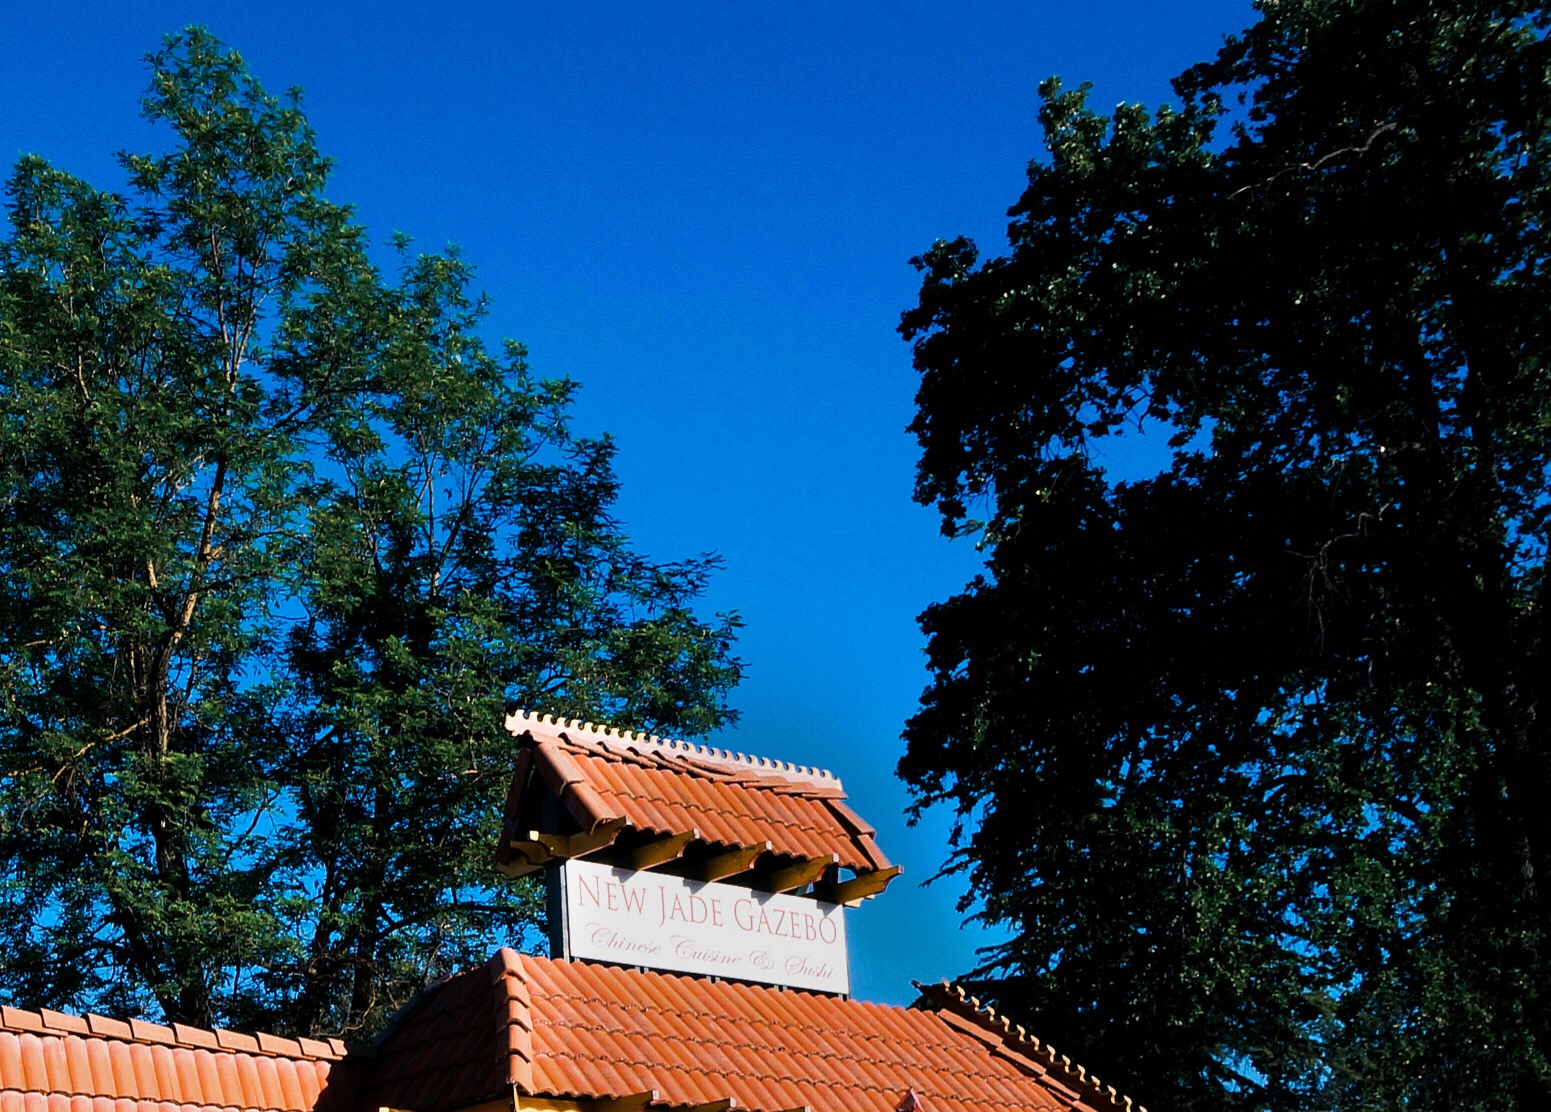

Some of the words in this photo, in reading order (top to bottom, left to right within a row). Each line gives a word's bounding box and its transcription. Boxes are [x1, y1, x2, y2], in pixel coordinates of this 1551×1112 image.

[578, 873, 647, 915] NEW
[659, 886, 724, 928] JADE
[734, 898, 837, 944] GAZEBO
[585, 922, 662, 955] Chinese
[669, 934, 741, 967] Cuisine
[749, 950, 775, 970] &
[785, 955, 835, 979] Sushi
